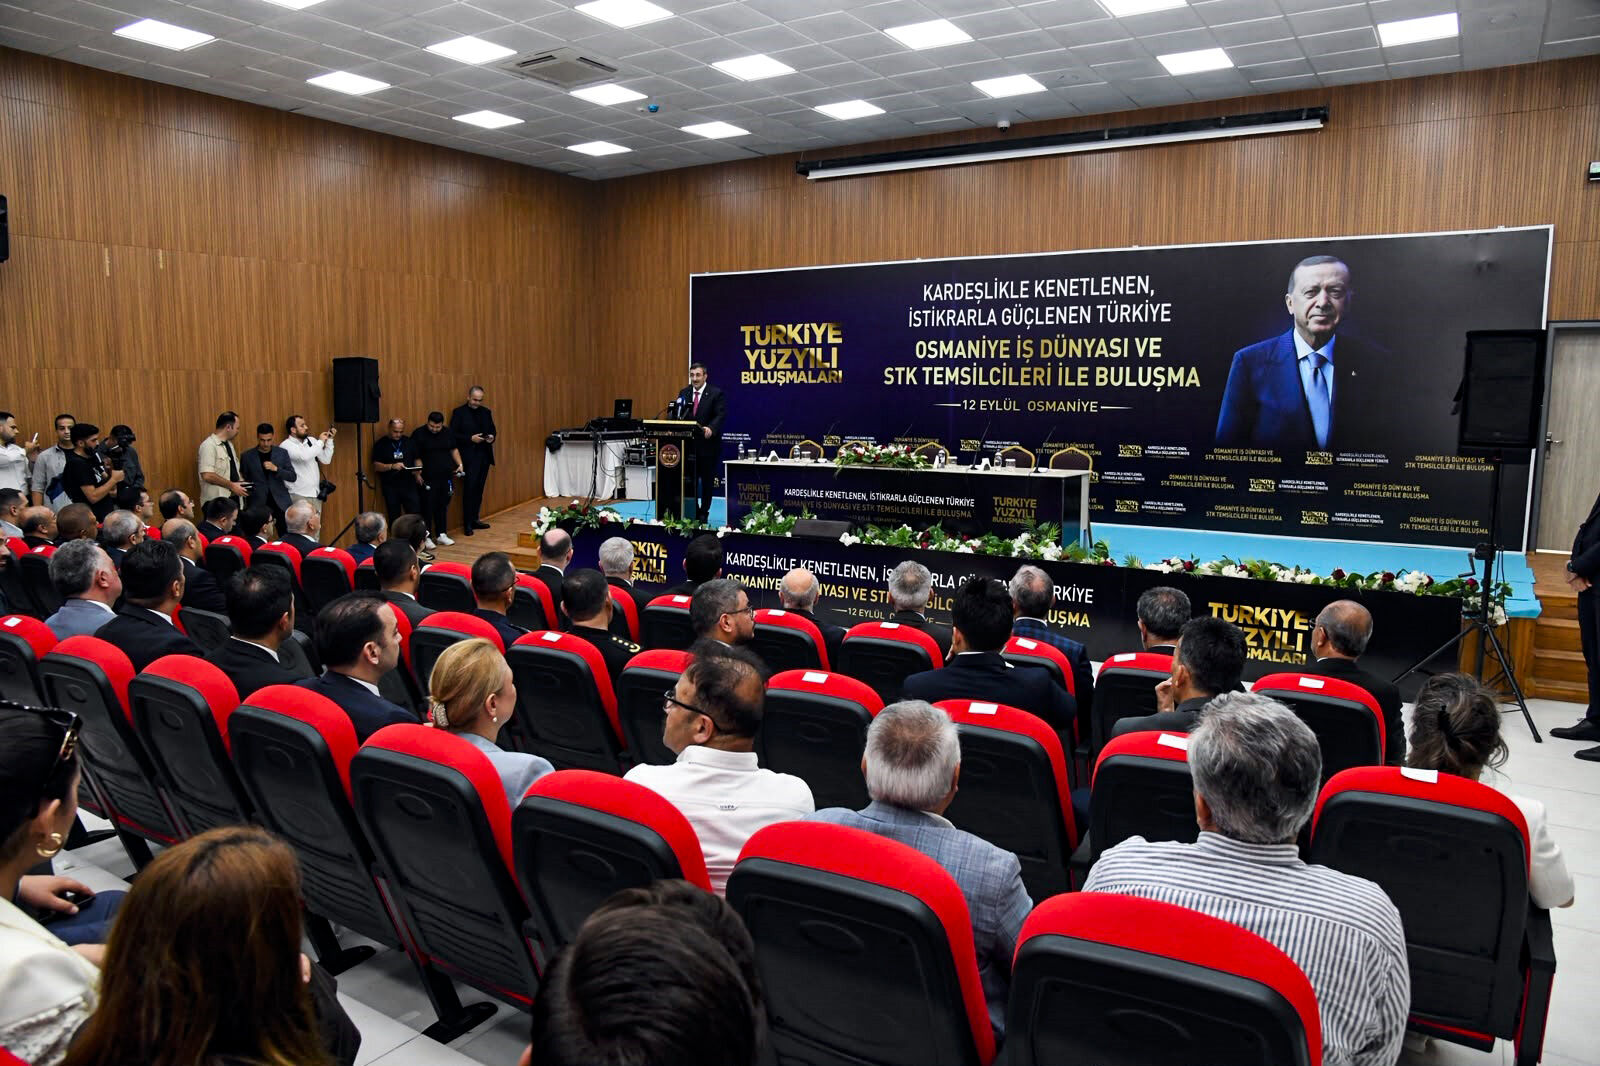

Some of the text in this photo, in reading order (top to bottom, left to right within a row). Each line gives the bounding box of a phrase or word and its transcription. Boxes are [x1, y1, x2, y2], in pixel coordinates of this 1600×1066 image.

[923, 275, 1154, 302] KARDEŞLİKLE KENETLENEN,
[908, 301, 1172, 329] İSTİKRARLA GÜÇLENEN TÜRKİYE
[916, 335, 1162, 360] OSMANİYE İŞ DÜNYASI VE
[740, 370, 842, 386] BULUŞMALARI
[884, 364, 1200, 389] STK TEMSİLCİLERİ İLE BULUŞMA
[962, 398, 1098, 412] 12 EYLÜL OSMANİYE
[784, 488, 974, 507] KARDEŞLİKLE KENETLENEN, İSTİKRARLA GÜÇLENEN TÜRKİYE
[726, 552, 796, 572] KARDEŞLİKLE
[800, 560, 879, 582] KENETLENEN,
[852, 587, 867, 601] VE
[848, 608, 857, 616] 12
[859, 608, 885, 620] EYLÜL
